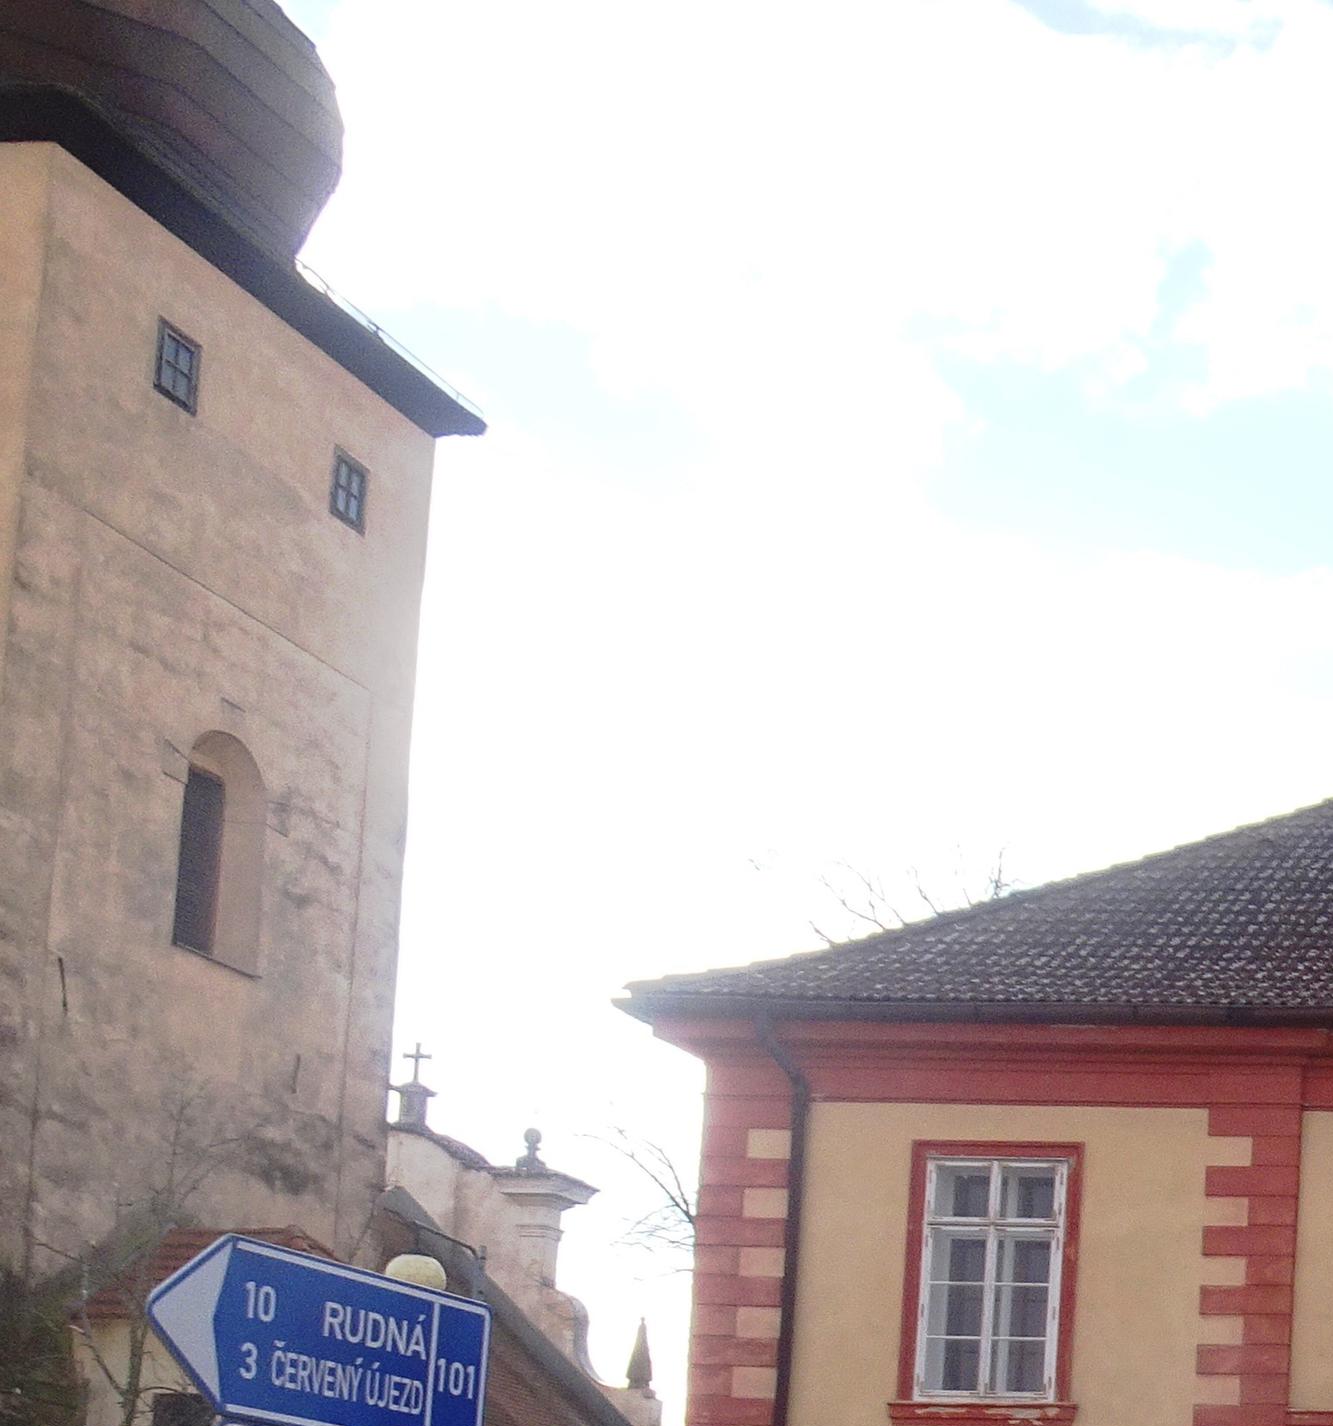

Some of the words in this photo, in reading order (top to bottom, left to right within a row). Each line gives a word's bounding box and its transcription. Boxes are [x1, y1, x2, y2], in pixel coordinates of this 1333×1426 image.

[245, 1281, 275, 1322] 10
[323, 1301, 426, 1360] RUDNÁ
[240, 1343, 257, 1380] 3
[271, 1339, 364, 1399] ČERVENÝ
[365, 1361, 424, 1416] ÚJEZD
[437, 1358, 476, 1399] 101
